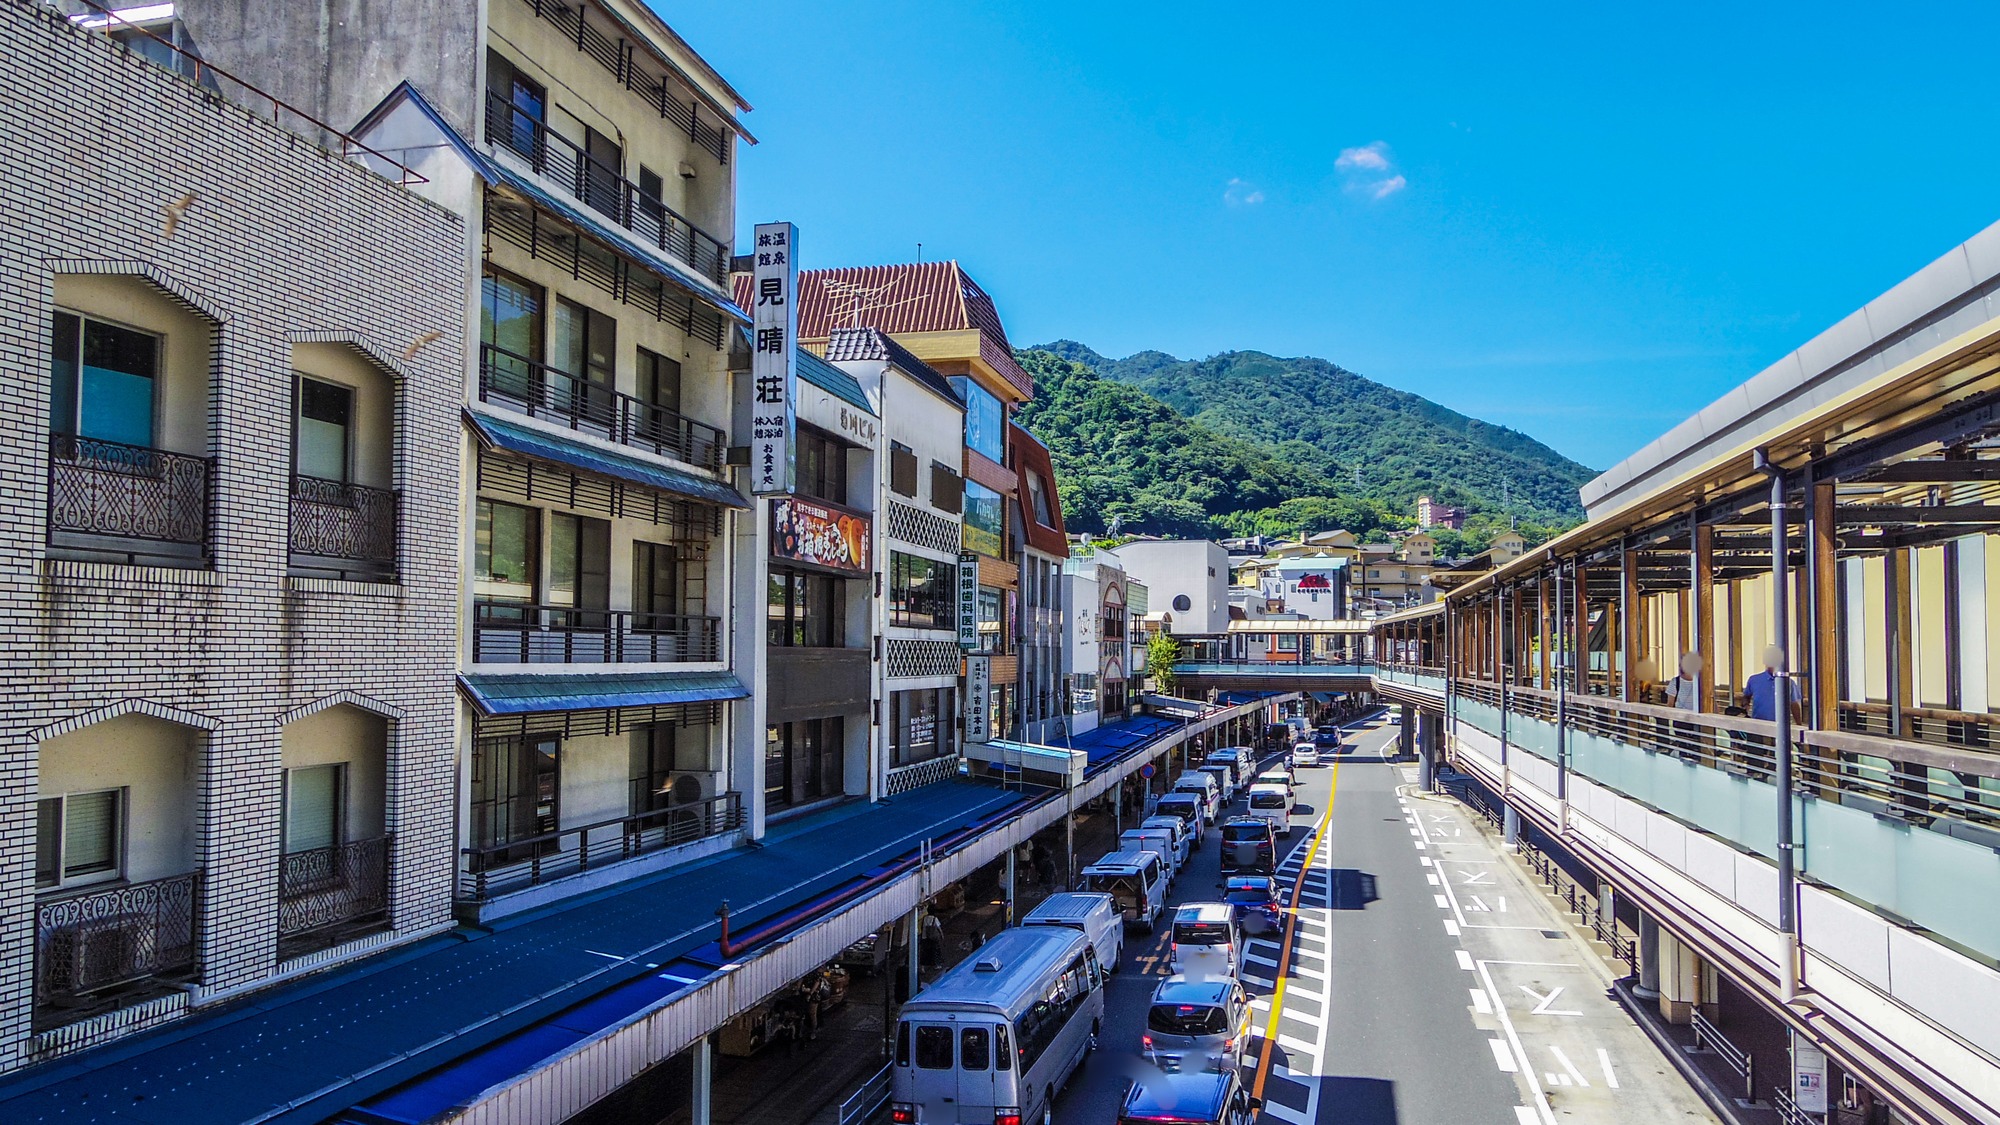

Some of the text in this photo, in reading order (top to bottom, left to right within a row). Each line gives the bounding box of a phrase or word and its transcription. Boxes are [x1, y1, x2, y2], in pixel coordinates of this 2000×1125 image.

[758, 234, 771, 266] 旅館
[773, 232, 785, 265] 温泉
[756, 278, 784, 403] 見晴荘
[754, 417, 764, 439] 休憩
[764, 417, 774, 439] 入浴
[774, 416, 784, 438] 宿泊
[763, 444, 774, 485] お食事処
[961, 567, 974, 639] 箱根歯科医院
[973, 696, 983, 735] 吉田本店
